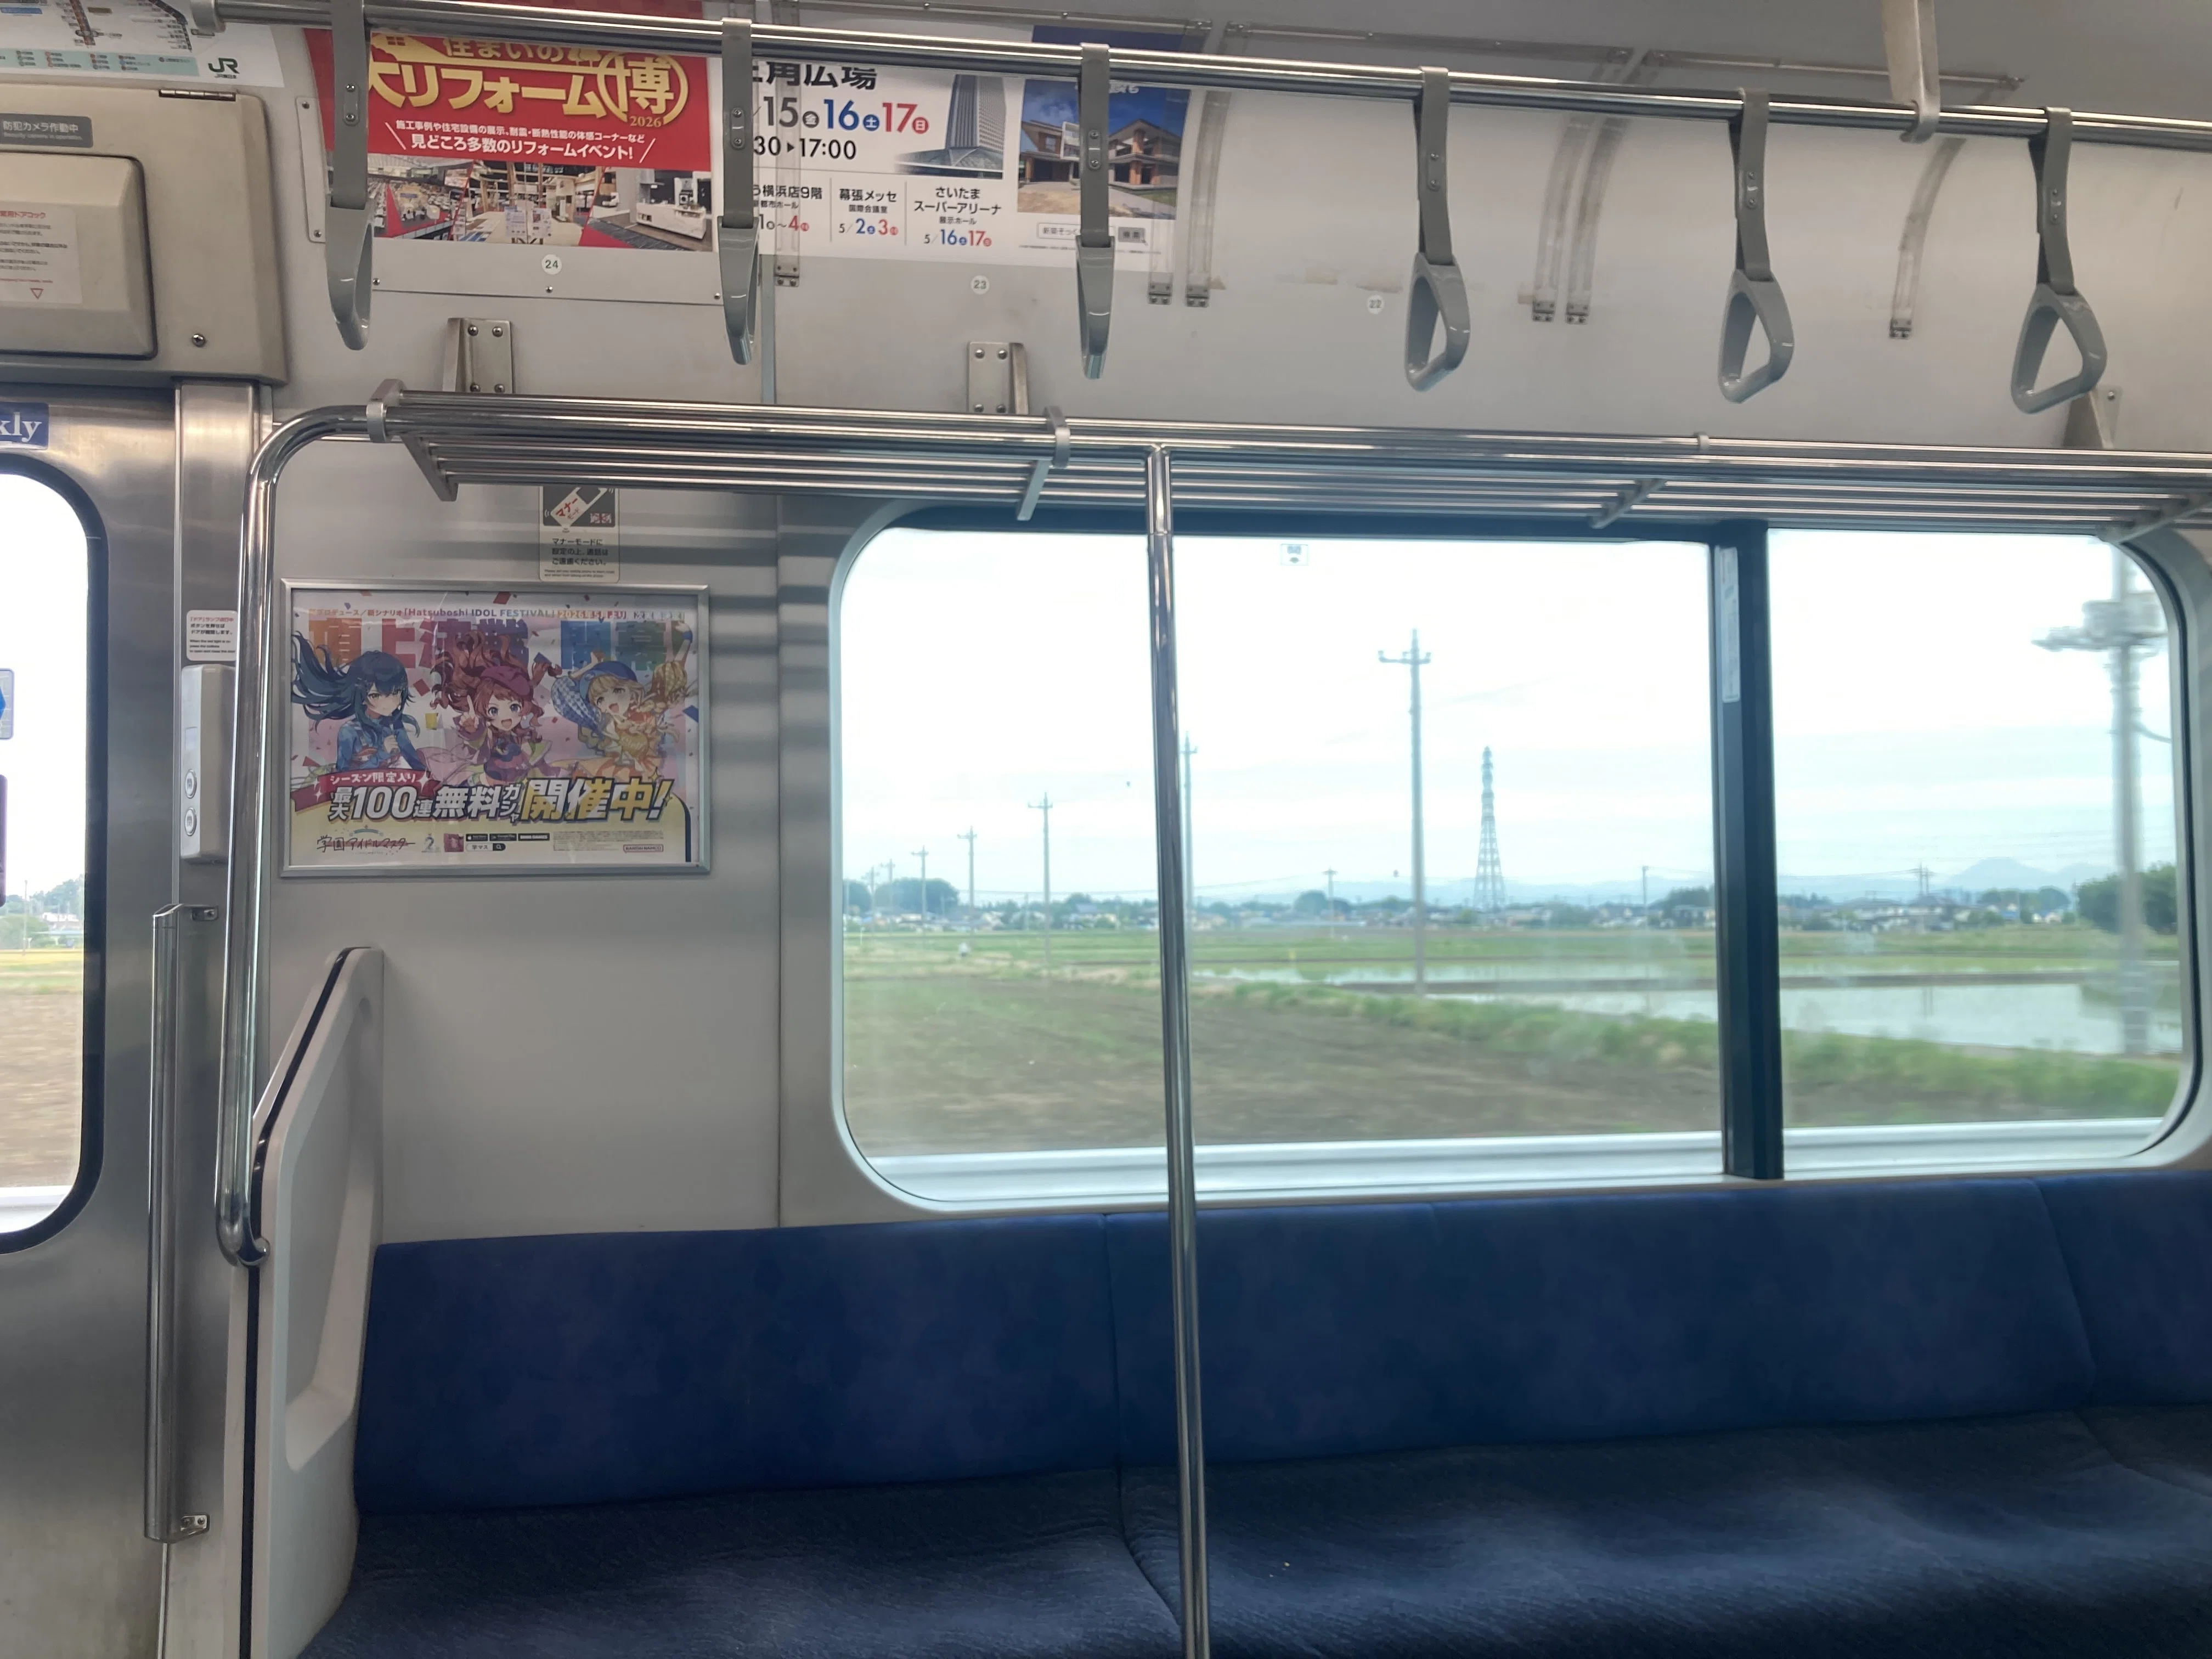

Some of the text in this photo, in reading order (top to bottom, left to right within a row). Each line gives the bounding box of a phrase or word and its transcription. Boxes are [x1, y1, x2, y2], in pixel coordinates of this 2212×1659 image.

[208, 58, 240, 74] JR
[3, 121, 78, 133] 防犯カメラ作動中
[630, 116, 662, 127] 2026
[799, 138, 857, 160] 17:00
[839, 188, 898, 202] 幕張メッセ
[935, 187, 981, 199] さいたま
[913, 200, 1001, 215] スーパーアリーナ
[545, 259, 558, 269] 24
[973, 280, 988, 290] 23
[1369, 299, 1383, 309] 22
[552, 538, 603, 546] マナーモードに
[471, 609, 497, 617] IDOL
[330, 771, 416, 784] シーズン限定入り
